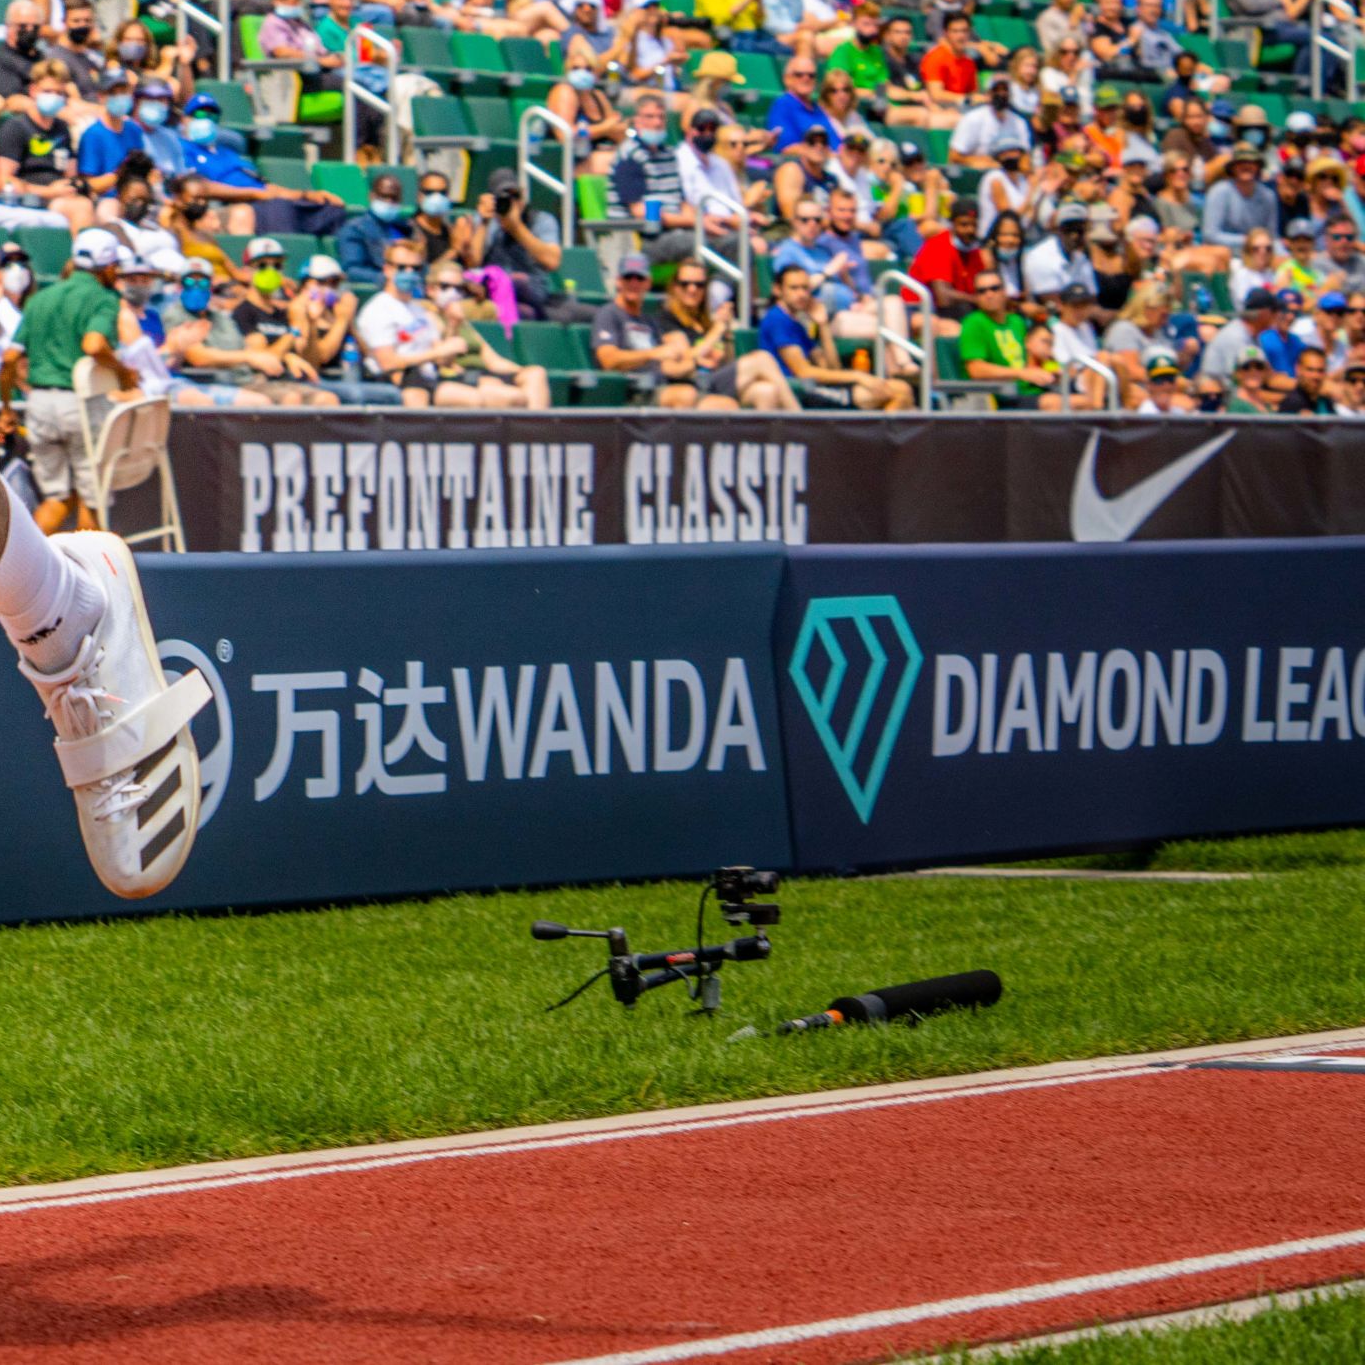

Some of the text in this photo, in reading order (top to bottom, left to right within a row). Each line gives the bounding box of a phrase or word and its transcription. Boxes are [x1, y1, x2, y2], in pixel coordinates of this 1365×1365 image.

[240, 441, 808, 553] PREFONTAINE CLASSIC
[251, 657, 767, 802] 万达 WANDA
[932, 648, 1228, 757] DIAMOND
